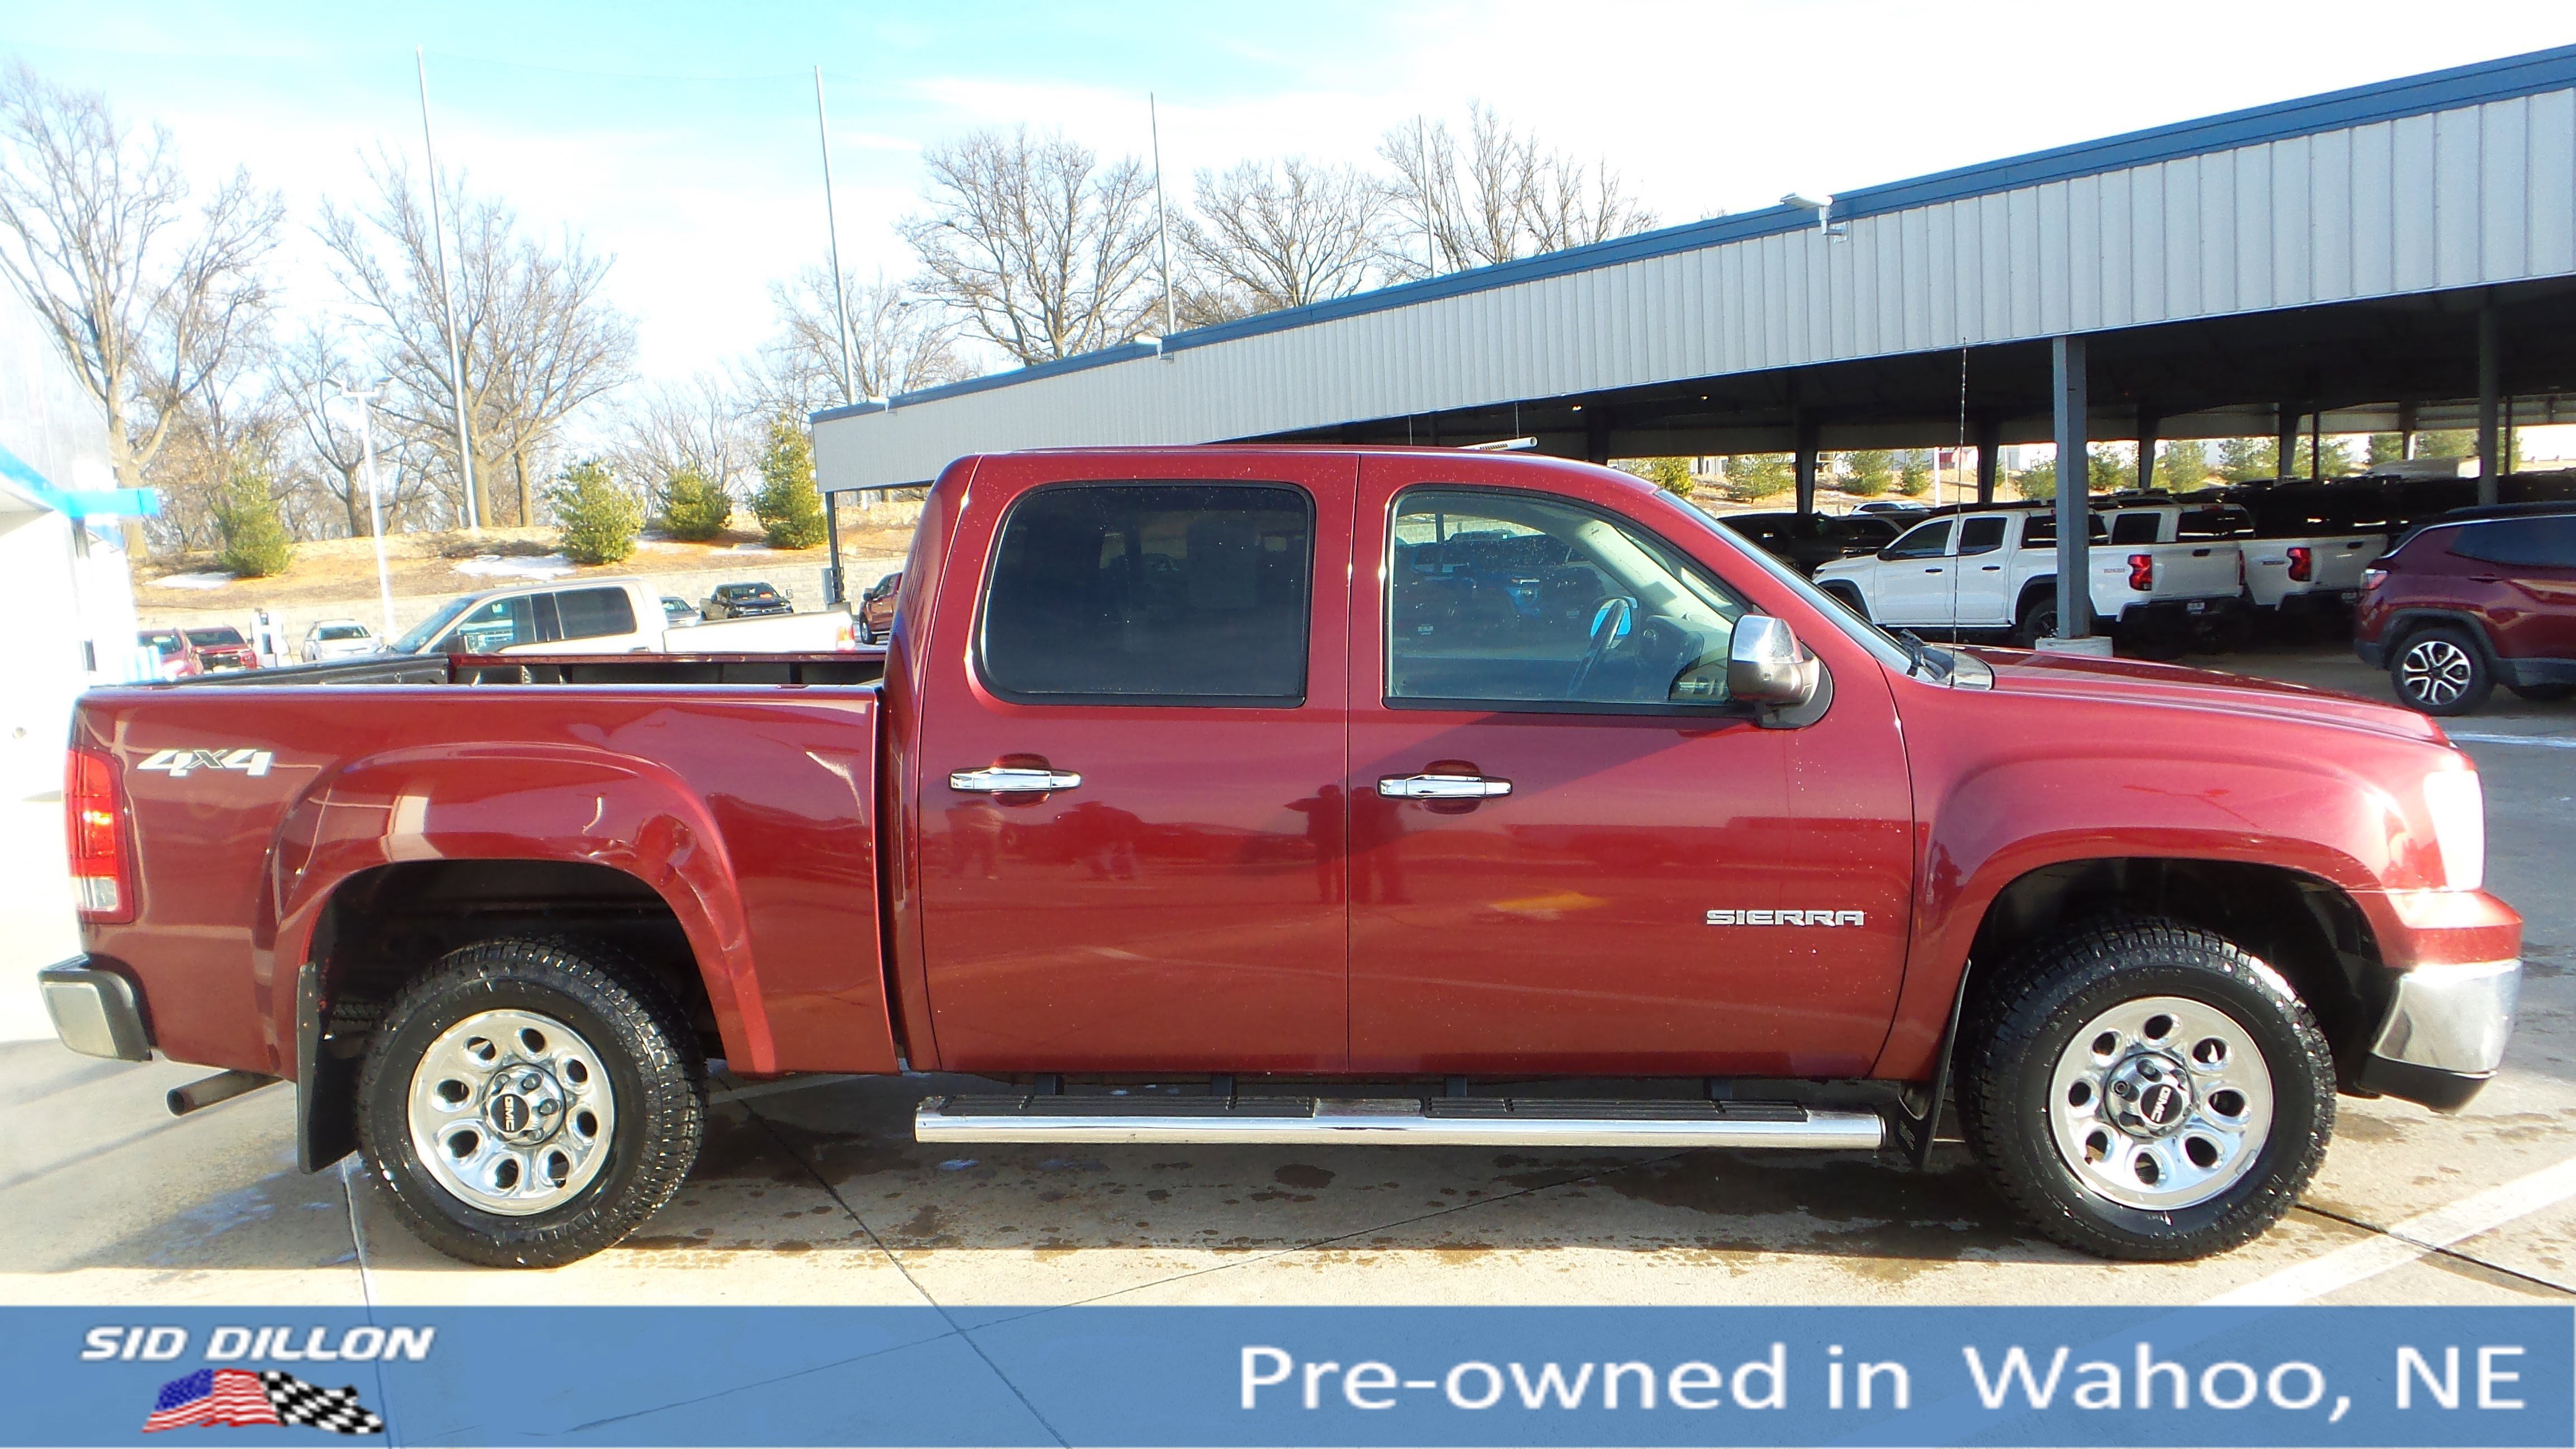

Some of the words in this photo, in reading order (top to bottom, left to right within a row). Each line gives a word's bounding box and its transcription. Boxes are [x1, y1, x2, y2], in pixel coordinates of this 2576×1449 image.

[1707, 910, 1864, 926] SIERRA
[473, 1086, 494, 1123] GMC
[504, 1096, 514, 1131] GMC
